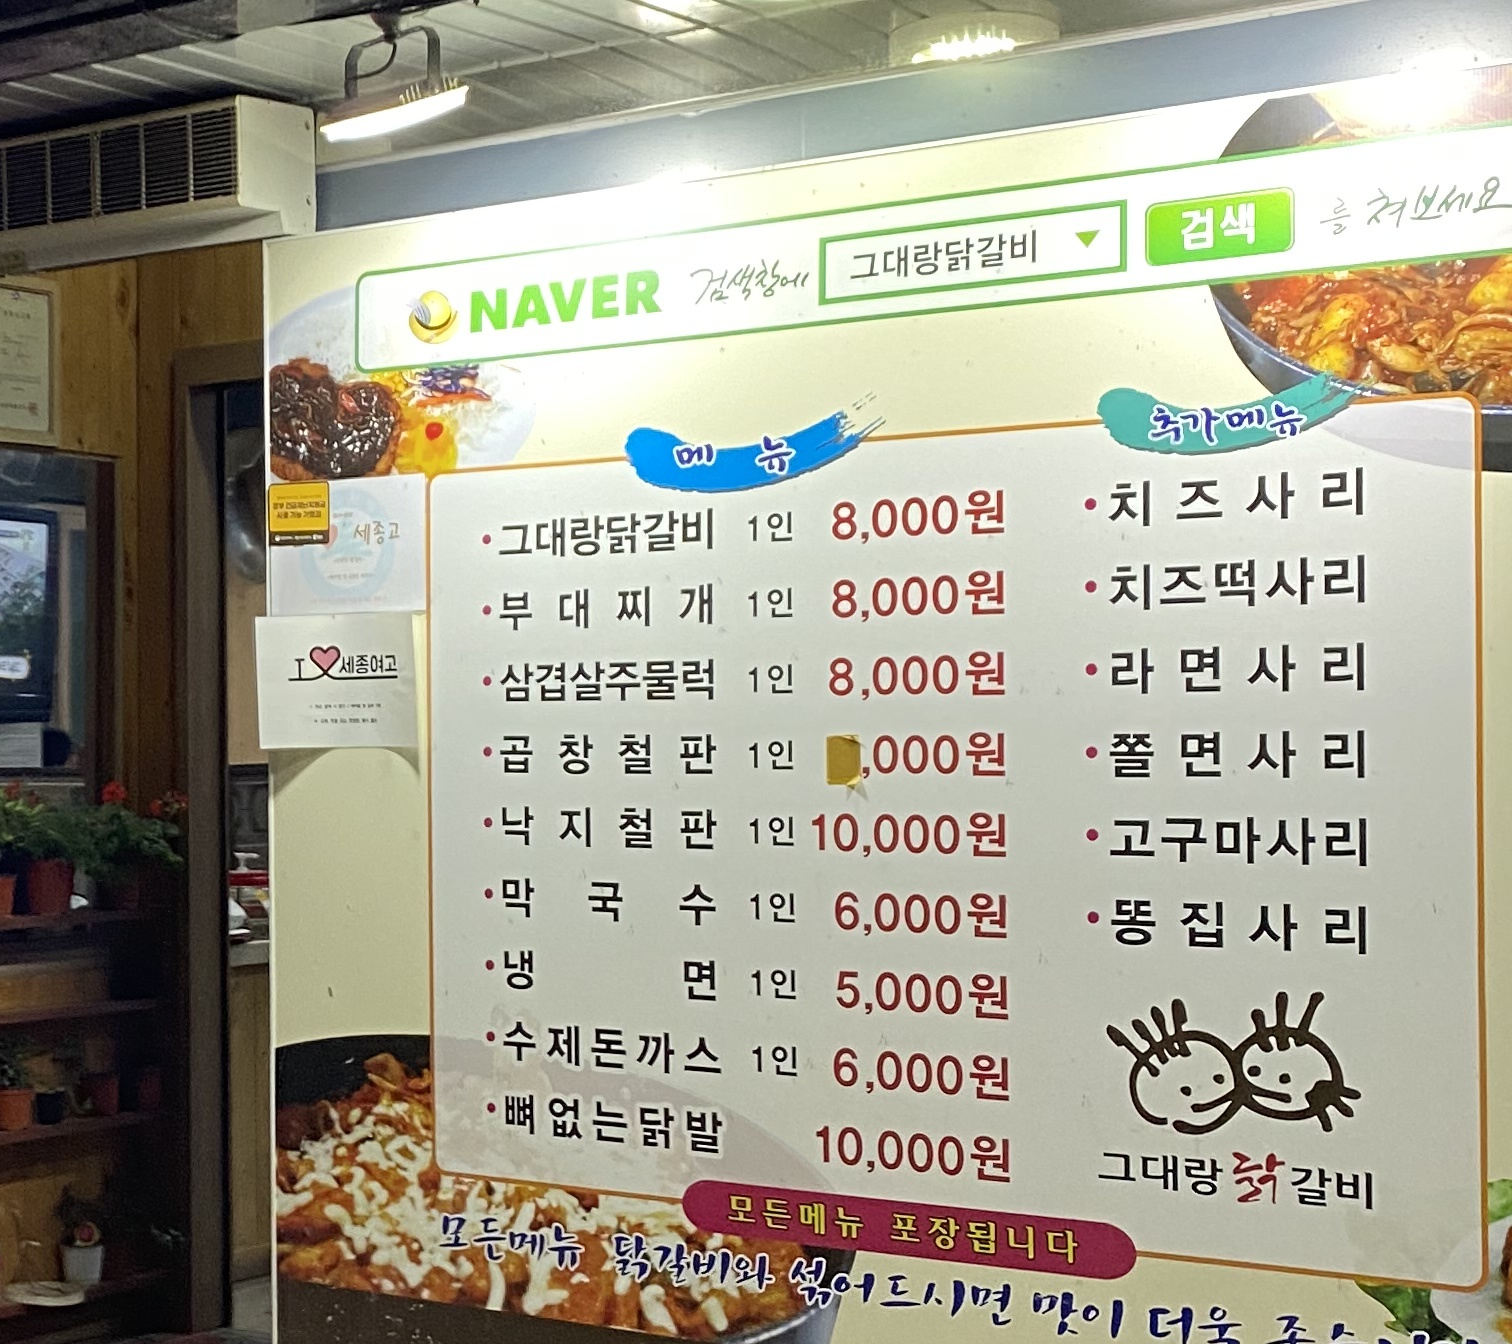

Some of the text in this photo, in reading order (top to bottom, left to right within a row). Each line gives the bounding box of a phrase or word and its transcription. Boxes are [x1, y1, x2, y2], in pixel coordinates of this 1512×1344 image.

[468, 269, 663, 334] NAVER
[690, 258, 811, 306] 검색창에
[849, 228, 1039, 282] 그대랑닭갈비
[1179, 201, 1258, 252] 검색
[1320, 197, 1351, 235] 를
[1149, 401, 1307, 445] 추가메뉴
[353, 521, 400, 544] 세종고
[499, 489, 1005, 557] 그대랑닭갈비 1인 8,000원
[747, 587, 794, 619] 1인
[832, 570, 1006, 622] 8,000원
[1109, 554, 1365, 610] 치즈떡사리
[338, 655, 398, 674] 세종여고
[499, 651, 1006, 702] 삼겹살주물럭 1인 8,000원
[747, 739, 795, 771] 1인
[828, 732, 1006, 779] ,000원
[748, 816, 795, 847] 1인
[811, 811, 1007, 857] 10,000원
[1109, 817, 1367, 866] 고구마사리
[749, 892, 796, 924] 1인
[834, 891, 1007, 938] 6,000원
[750, 968, 797, 1001] 1인
[835, 970, 1009, 1020] 5,000원
[502, 1021, 1010, 1101] 수제돈까스 1인 6,000원
[815, 1126, 1011, 1183] 10,000원
[439, 1214, 583, 1271] 모든메뉴
[612, 1233, 776, 1292] 닭갈비와
[726, 1195, 1080, 1264] 모든메뉴 포장됩니다
